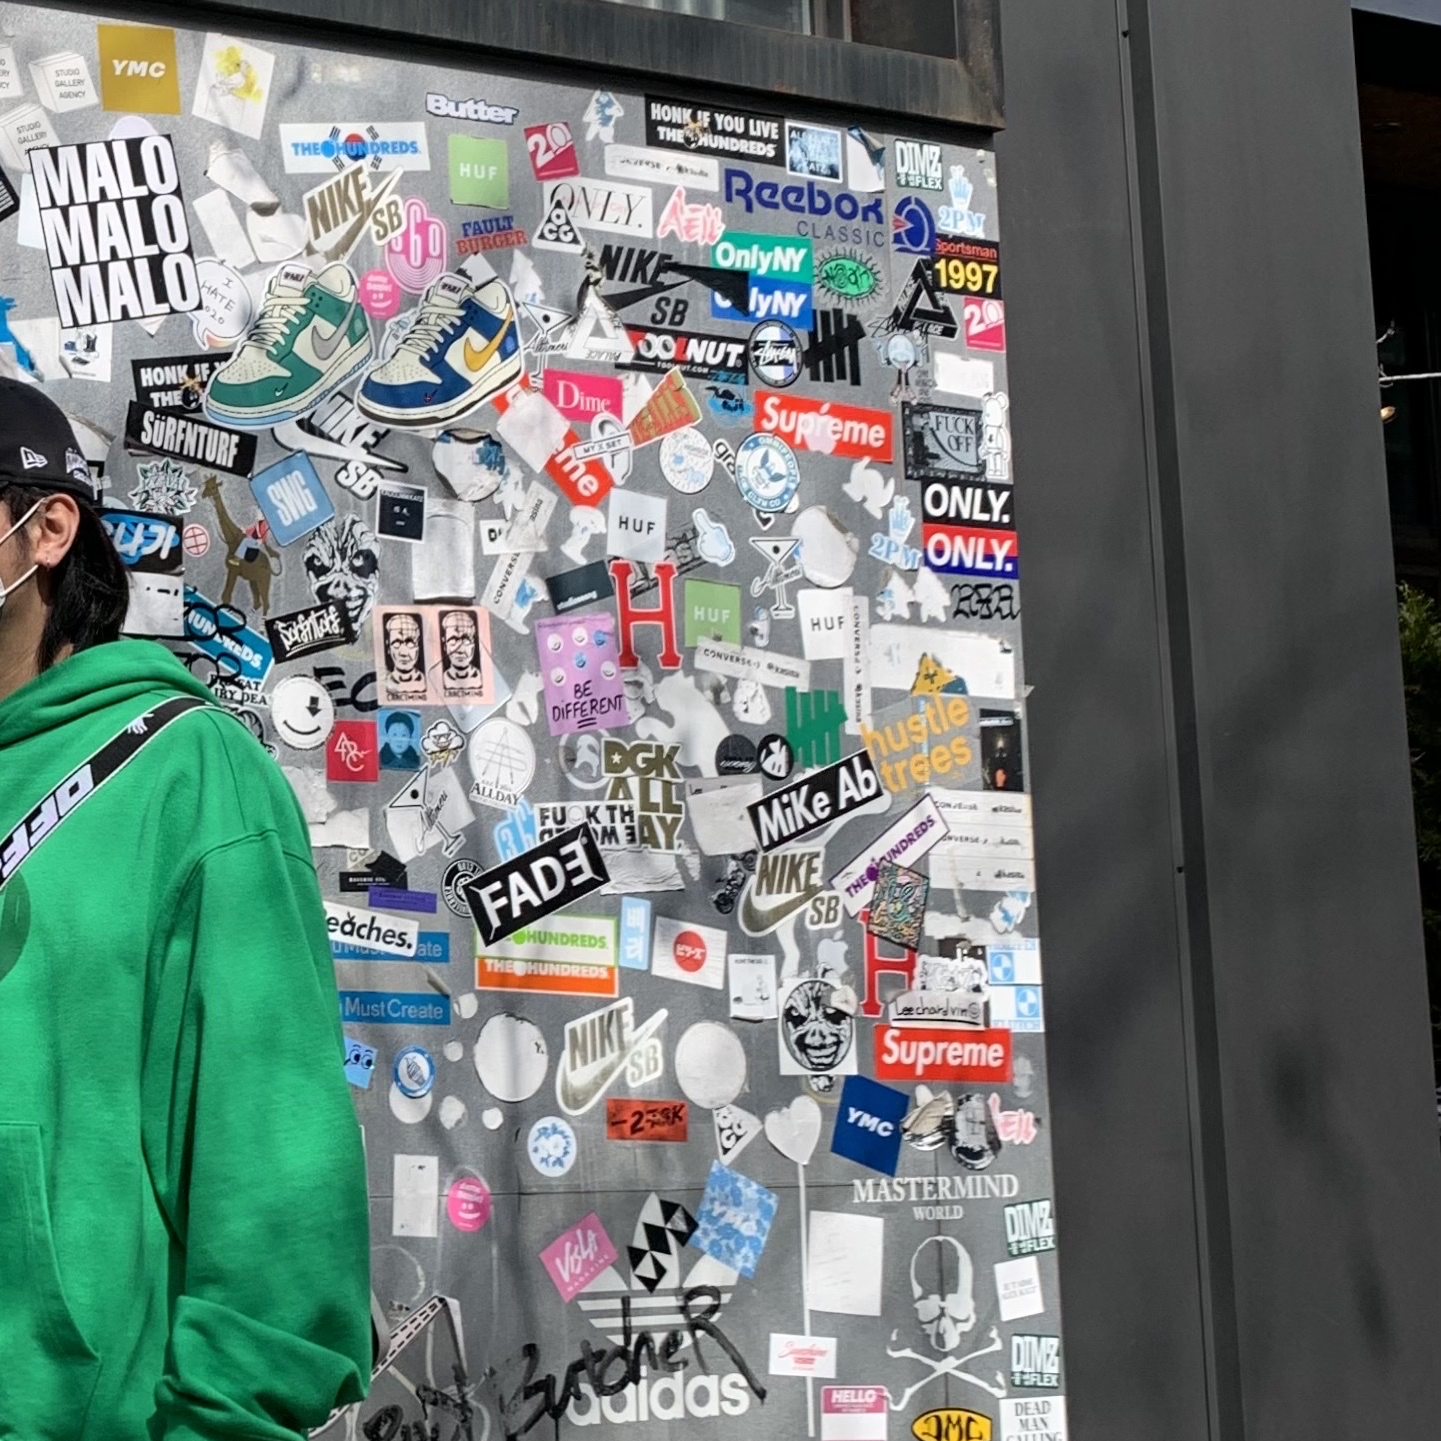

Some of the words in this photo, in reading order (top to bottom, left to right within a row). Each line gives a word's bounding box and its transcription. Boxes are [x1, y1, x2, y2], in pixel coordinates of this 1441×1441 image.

[53, 77, 86, 90] GALLERY
[54, 67, 80, 79] STUDIO
[111, 59, 167, 79] YMC
[426, 92, 519, 125] Butter
[650, 103, 692, 123] HONK
[714, 112, 745, 134] YOU
[749, 119, 779, 140] LIVE
[291, 141, 322, 157] THE
[334, 139, 420, 156] HUNDREDS
[657, 126, 684, 144] THE
[699, 135, 776, 158] HUNDREDS
[29, 135, 179, 208] MALO
[459, 164, 498, 182] HUF
[896, 140, 941, 178] DIMZ
[724, 168, 884, 225] Reebok
[910, 175, 942, 191] FLEX
[307, 165, 371, 241] NIKE
[41, 194, 190, 268] MALO
[371, 201, 403, 241] SB
[462, 215, 515, 236] FAULT
[797, 219, 885, 247] CLASSIC
[456, 230, 528, 255] BURGER
[935, 238, 998, 259] Sportsman
[599, 243, 673, 287] NIKE
[715, 243, 808, 274] OnlyNY
[51, 253, 202, 328] MALO
[935, 259, 999, 294] 1997
[650, 295, 688, 326] SB
[556, 381, 611, 413] Dime
[761, 396, 887, 447] Supreme
[935, 414, 974, 435] FUCK
[947, 434, 973, 453] OFF
[265, 469, 320, 527] SWG
[924, 483, 1010, 524] ONLY.
[618, 515, 656, 535] HUF
[926, 533, 1014, 572] ONLY.
[693, 605, 731, 623] HUF
[811, 616, 846, 631] HUF
[573, 680, 592, 698] BE
[551, 696, 624, 722] DIFFERENT
[861, 695, 969, 759] hustle
[603, 739, 680, 778] DGK
[880, 736, 972, 794] trees
[470, 782, 520, 808] ALLDAY
[838, 765, 878, 807] Ab
[478, 840, 603, 931] FADE
[756, 851, 821, 896] NIKE
[809, 896, 840, 925] SB
[527, 929, 609, 949] HUNDREDS
[527, 962, 609, 979] HUNDREDS
[345, 996, 385, 1016] Must
[387, 999, 443, 1019] Create
[568, 1002, 634, 1073] NIKE
[882, 1028, 1005, 1075] Supreme
[629, 1048, 658, 1081] SB
[846, 1107, 895, 1138] YMC
[852, 1173, 1020, 1204] MASTERMIND
[912, 1205, 964, 1222] WORLD
[1005, 1201, 1054, 1240] DIMZ
[555, 1228, 600, 1282] VISLA
[1027, 1237, 1055, 1252] FLEX
[1012, 1335, 1059, 1375] DIMZ
[1030, 1372, 1059, 1387] FLEX
[830, 1389, 877, 1403] HELLO
[1014, 1400, 1052, 1417] DEAD
[1020, 1415, 1050, 1432] MAN
